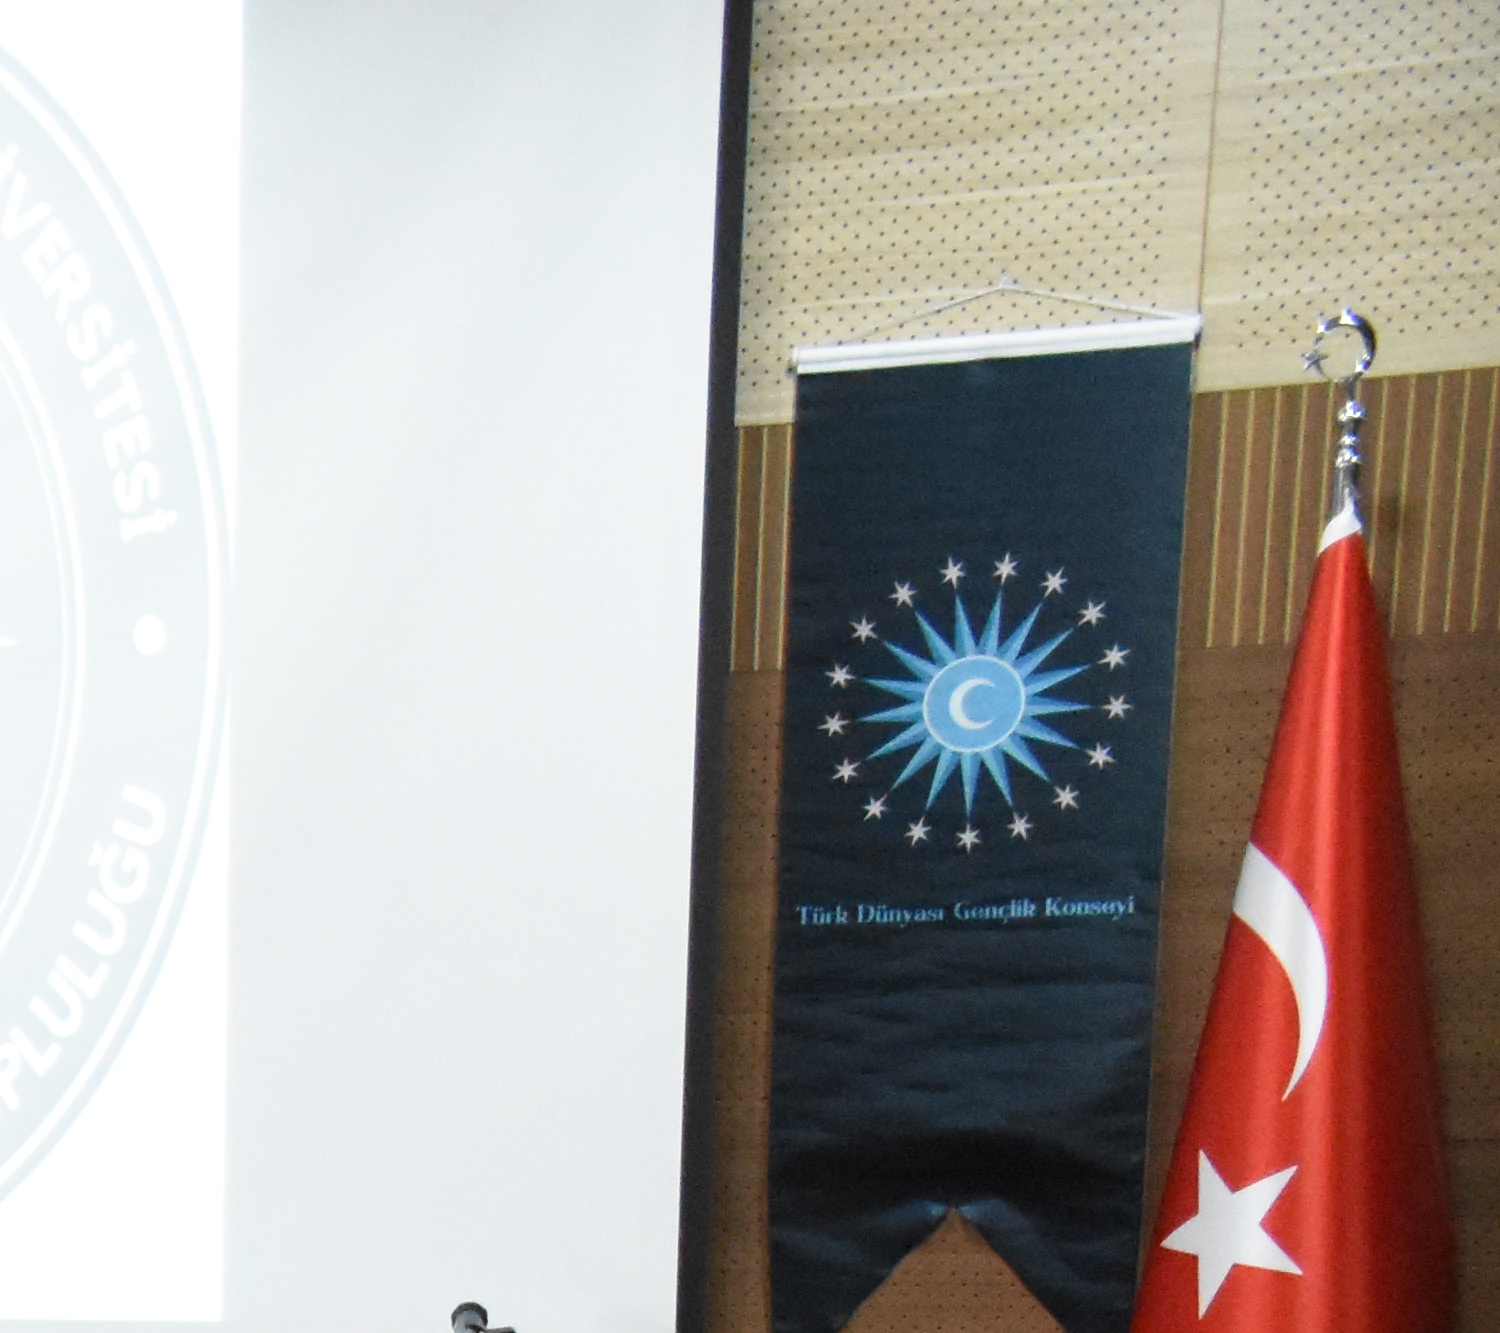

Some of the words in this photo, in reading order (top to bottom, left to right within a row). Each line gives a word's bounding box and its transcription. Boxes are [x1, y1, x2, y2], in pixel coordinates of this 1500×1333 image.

[796, 904, 849, 925] Türk
[857, 903, 945, 928] Dünyası
[954, 898, 1037, 924] Gençlik
[1045, 894, 1136, 922] Konseyi
